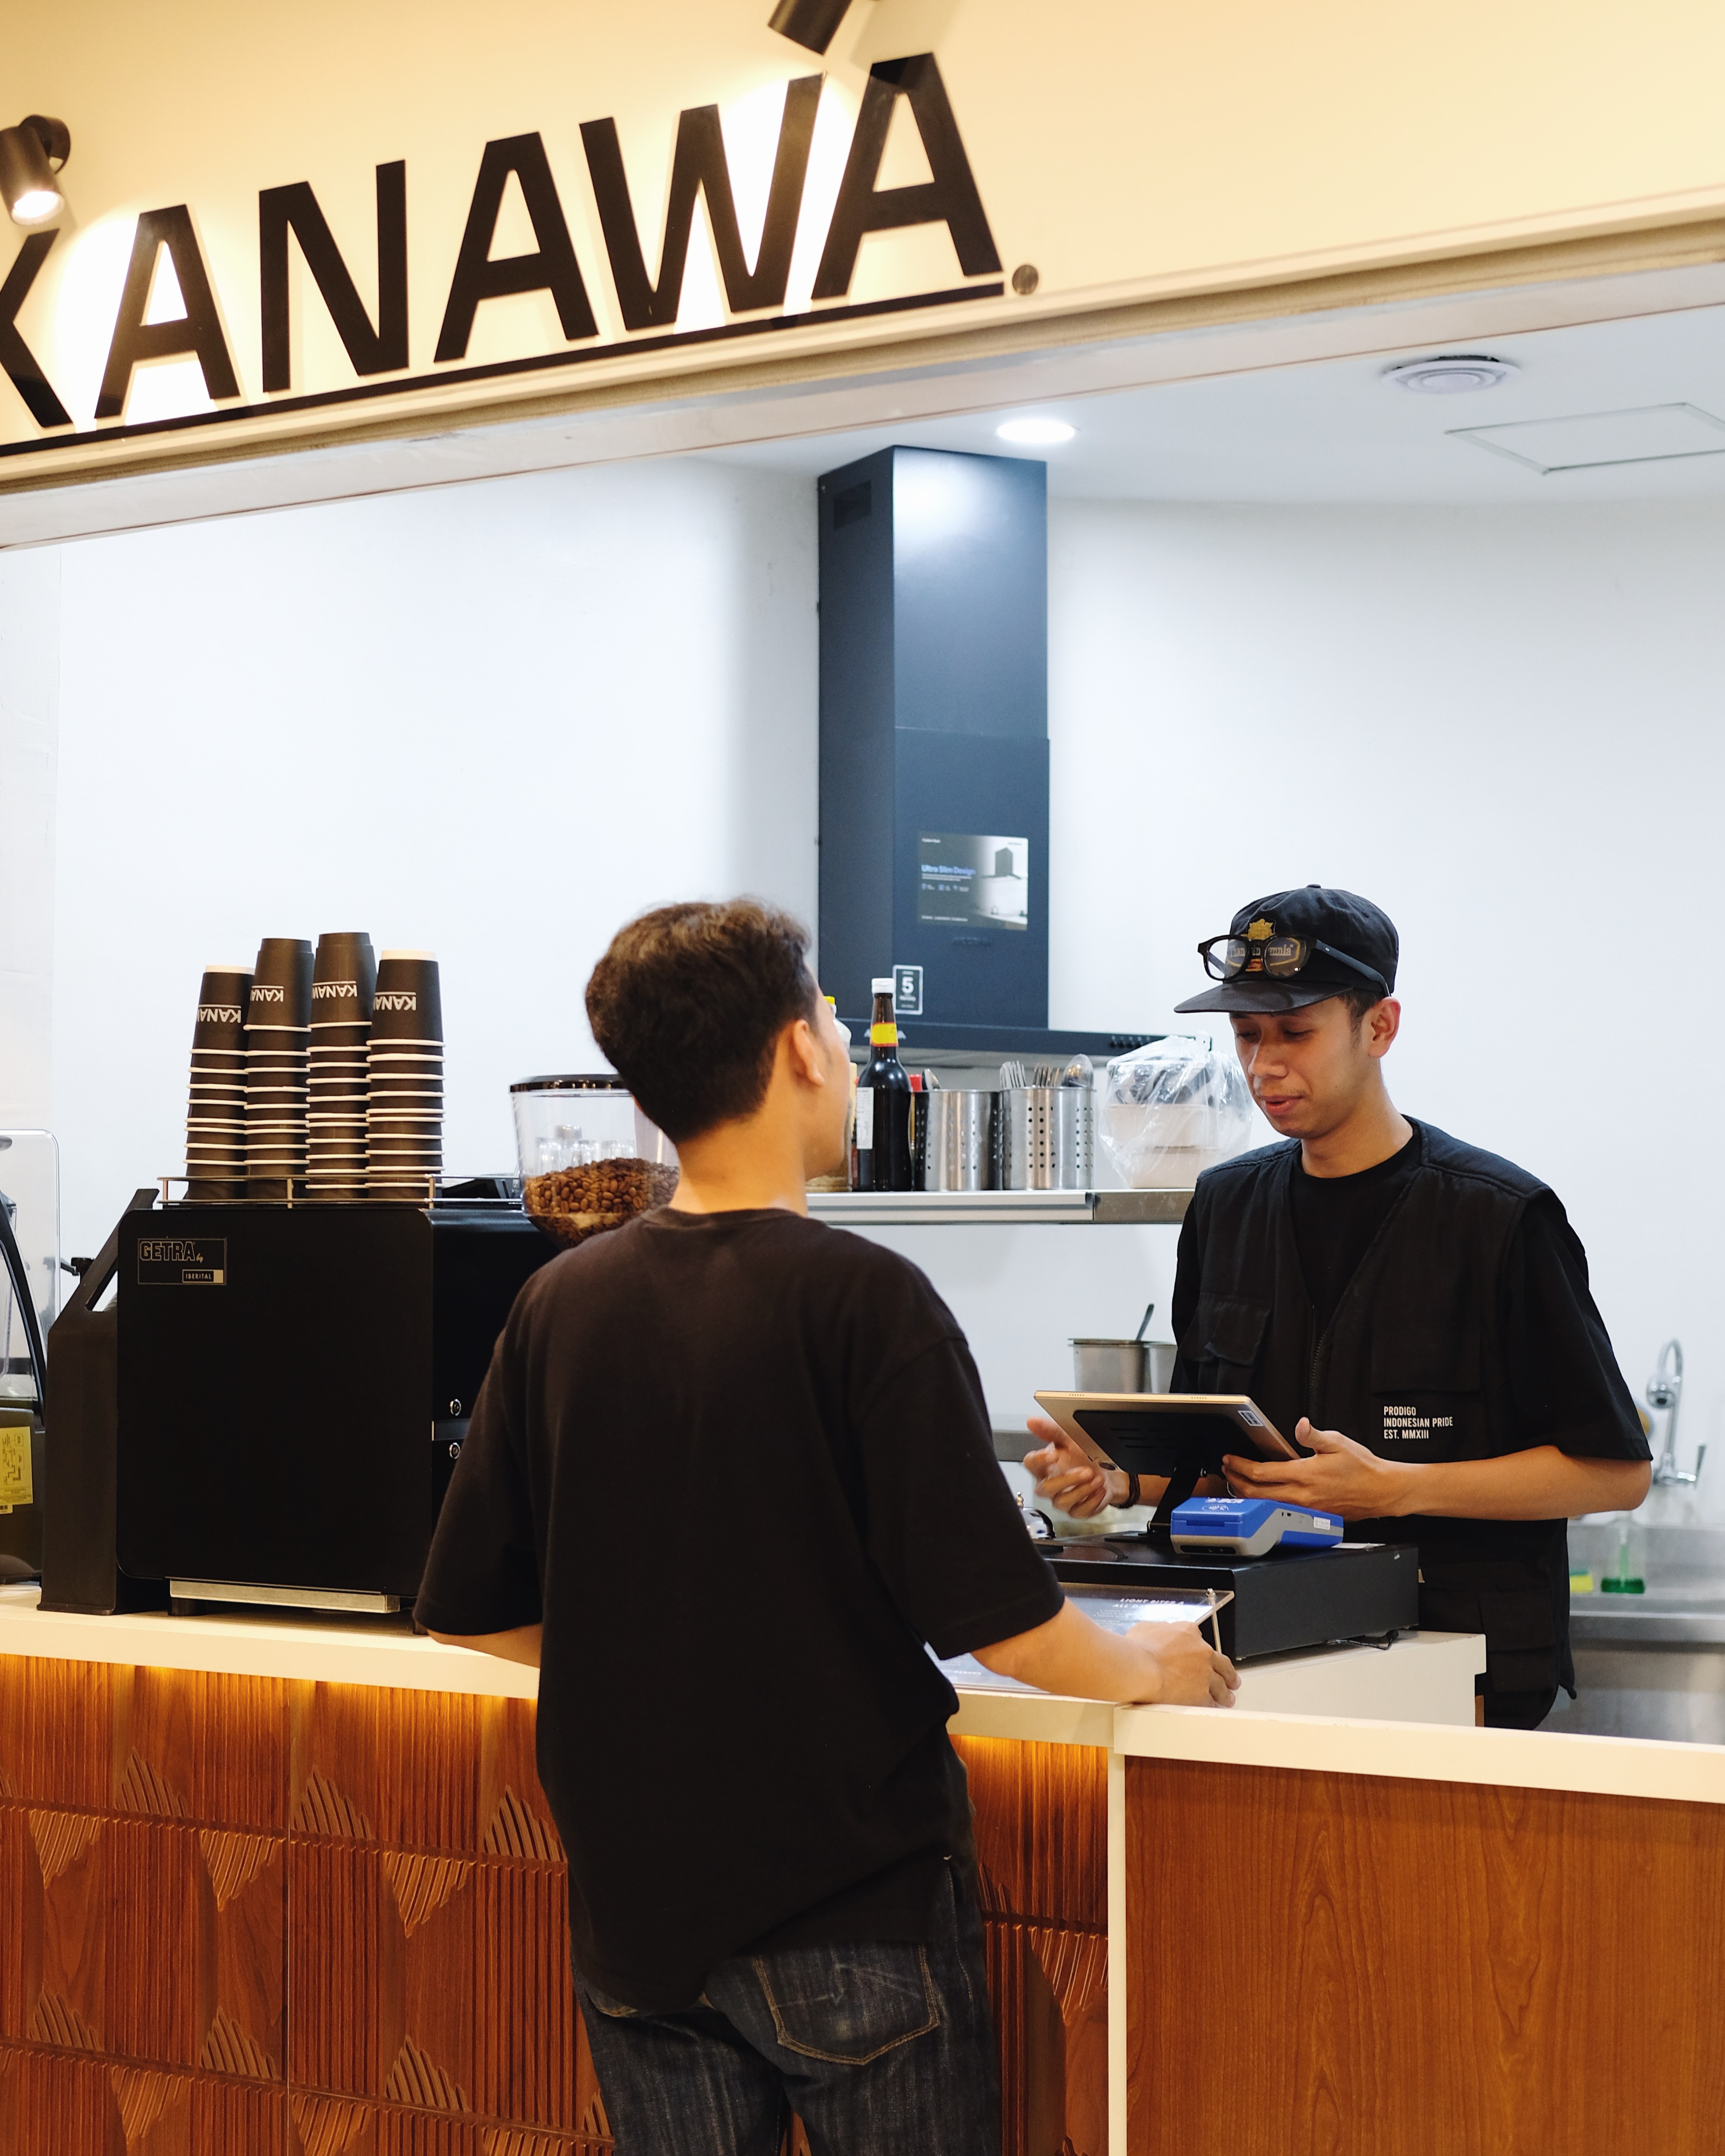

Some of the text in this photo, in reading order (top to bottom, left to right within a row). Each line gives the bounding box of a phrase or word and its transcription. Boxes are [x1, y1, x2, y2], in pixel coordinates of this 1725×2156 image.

[901, 976, 914, 994] 5
[140, 1241, 204, 1263] GETRA by
[1383, 1406, 1416, 1416] PRODIGO
[1383, 1416, 1453, 1428] INDONESIAN PRIDE
[1383, 1429, 1429, 1439] EST. MMXIII
